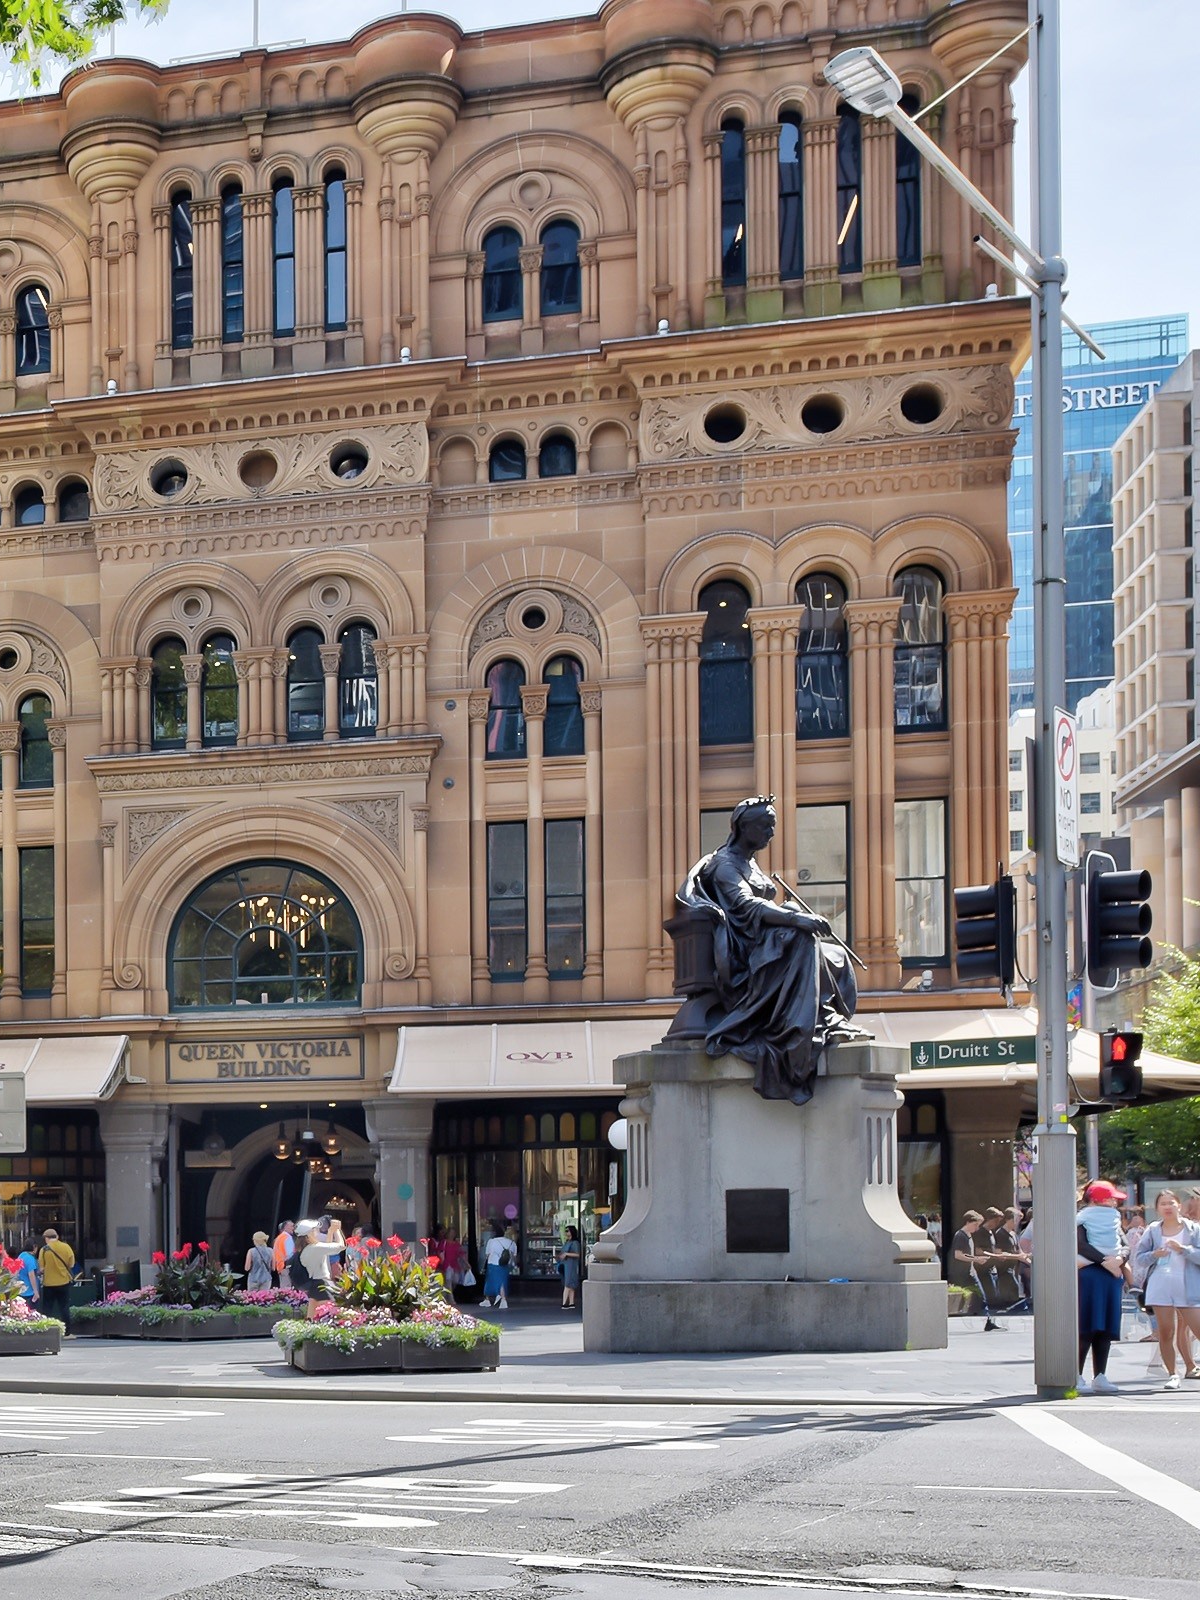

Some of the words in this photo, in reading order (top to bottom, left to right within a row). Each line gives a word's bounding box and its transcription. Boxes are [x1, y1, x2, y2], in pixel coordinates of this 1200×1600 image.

[1062, 380, 1161, 413] STREET
[1060, 786, 1072, 810] NO
[178, 1043, 246, 1062] QUEEN
[255, 1041, 352, 1059] VICTORIA
[506, 1051, 573, 1064] QVB
[938, 1043, 989, 1060] Druitt
[997, 1041, 1015, 1056] St
[216, 1060, 311, 1078] BUILDING
